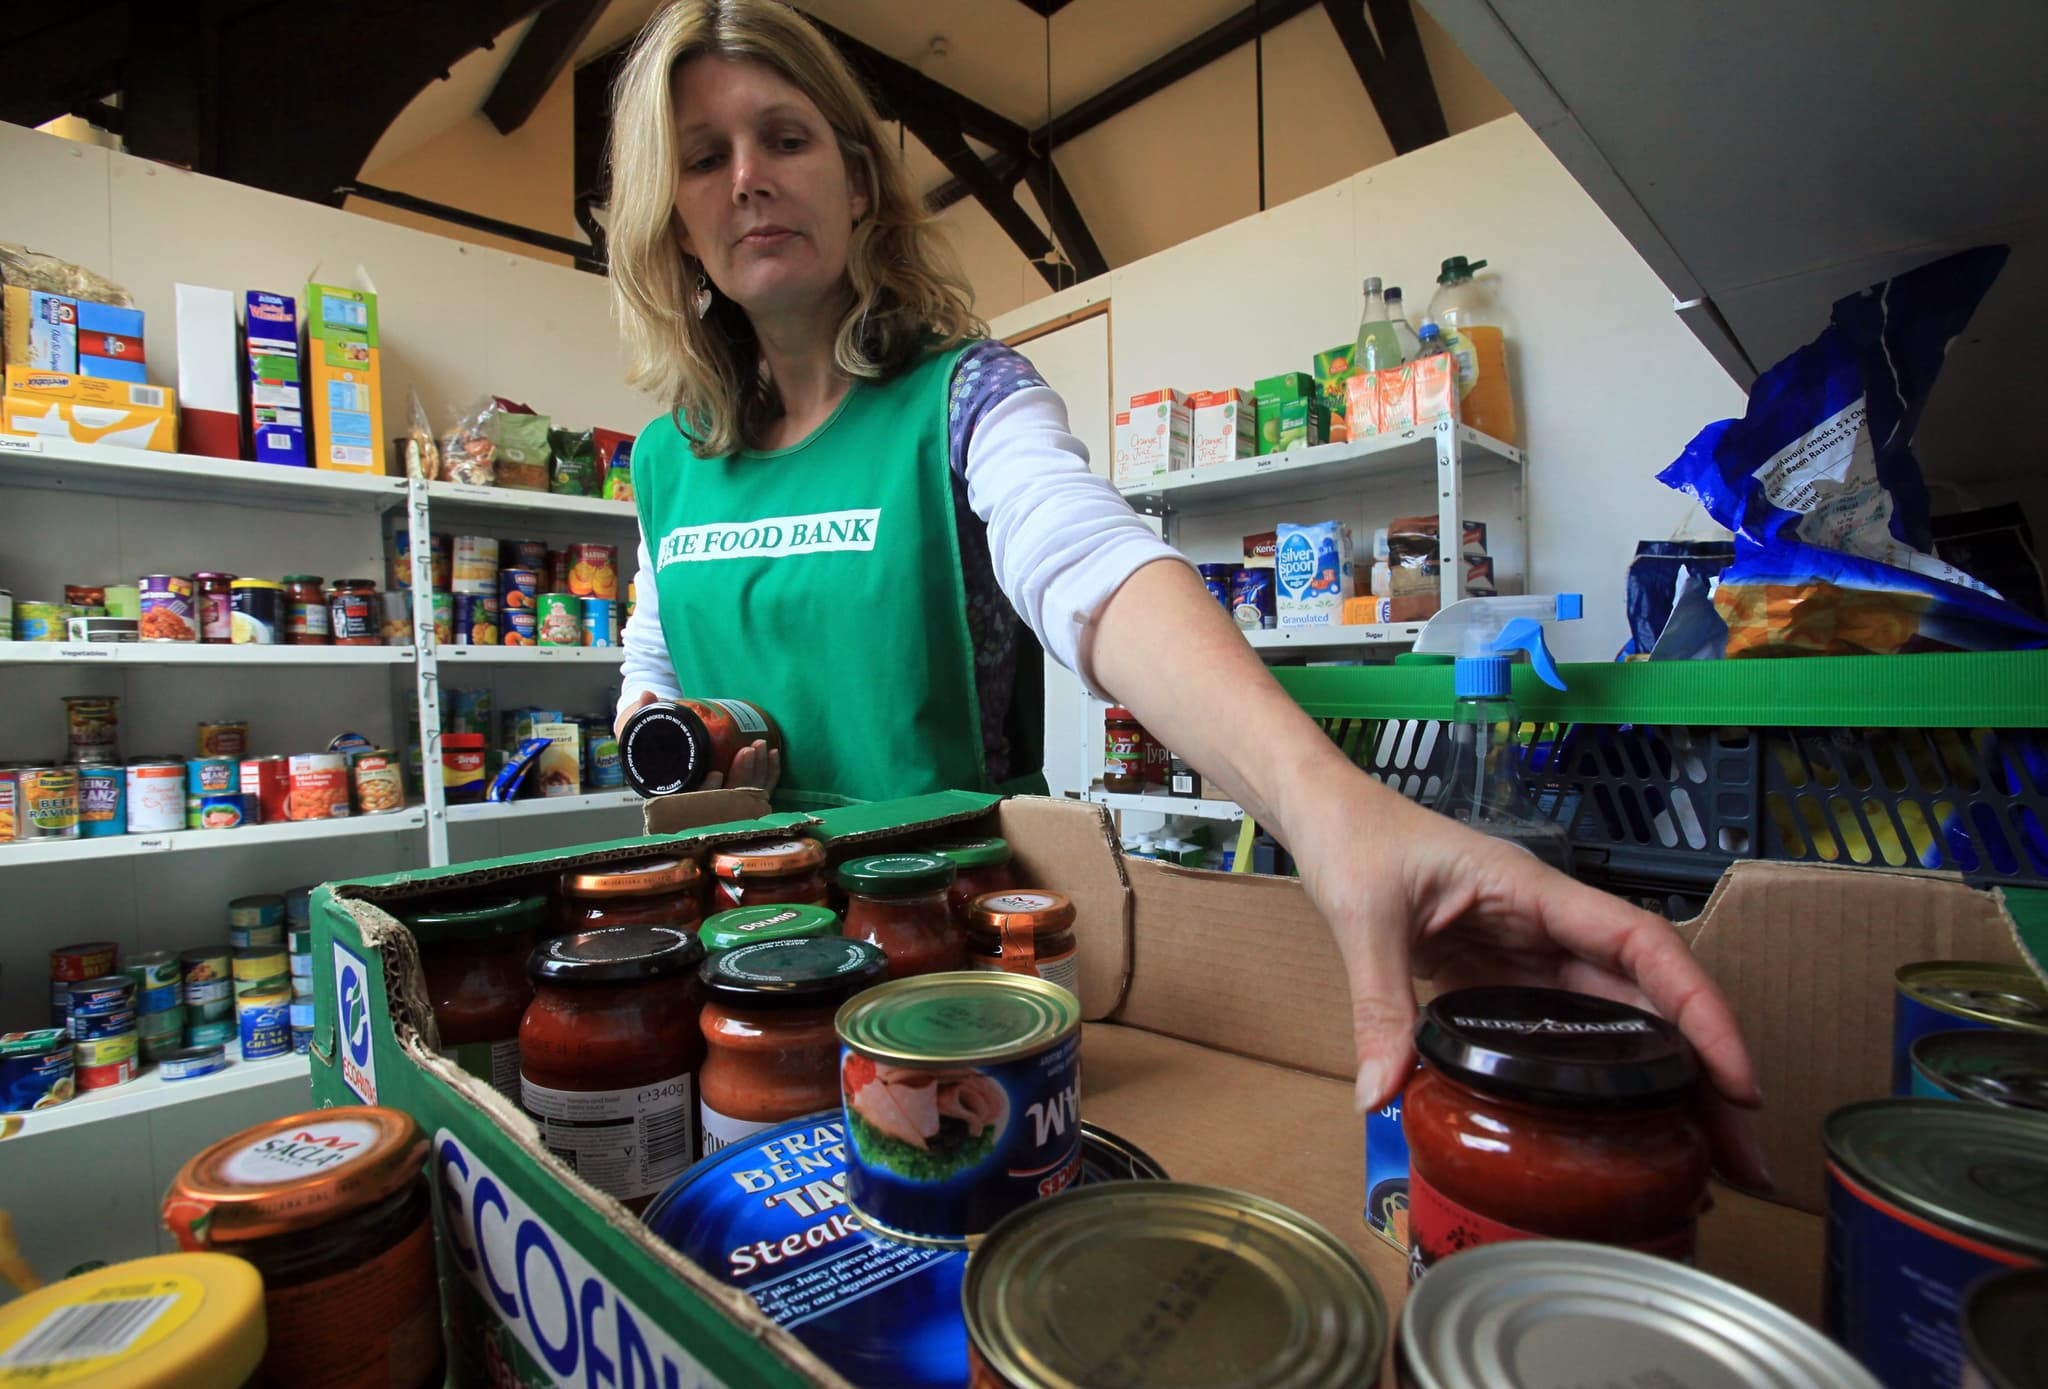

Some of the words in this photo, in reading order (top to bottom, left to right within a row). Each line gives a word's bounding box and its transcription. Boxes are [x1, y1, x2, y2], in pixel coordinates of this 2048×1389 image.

[1806, 427, 1837, 449] snacks
[1836, 420, 1843, 429] 5
[1786, 459, 1809, 475] Bacon
[1808, 435, 1845, 459] Rashers
[703, 526, 783, 553] FOOD
[789, 518, 875, 547] BANK
[1280, 560, 1315, 577] spoon
[1282, 548, 1314, 562] silver
[1282, 614, 1329, 624] Granulated
[738, 911, 798, 931] DOLMIO
[1453, 1016, 1525, 1031] SEEDS
[1546, 1018, 1655, 1033] CHANGE
[650, 1083, 684, 1101] 340g
[1025, 1085, 1081, 1147] AM
[728, 1214, 864, 1277] Steak
[787, 1278, 839, 1304] covered
[837, 1271, 853, 1283] in
[854, 1268, 862, 1276] a
[792, 1301, 812, 1317] by
[812, 1292, 837, 1307] our
[837, 1265, 895, 1296] signature
[894, 1252, 922, 1273] puff
[796, 1267, 830, 1288] Juicy
[831, 1252, 869, 1274] pieces
